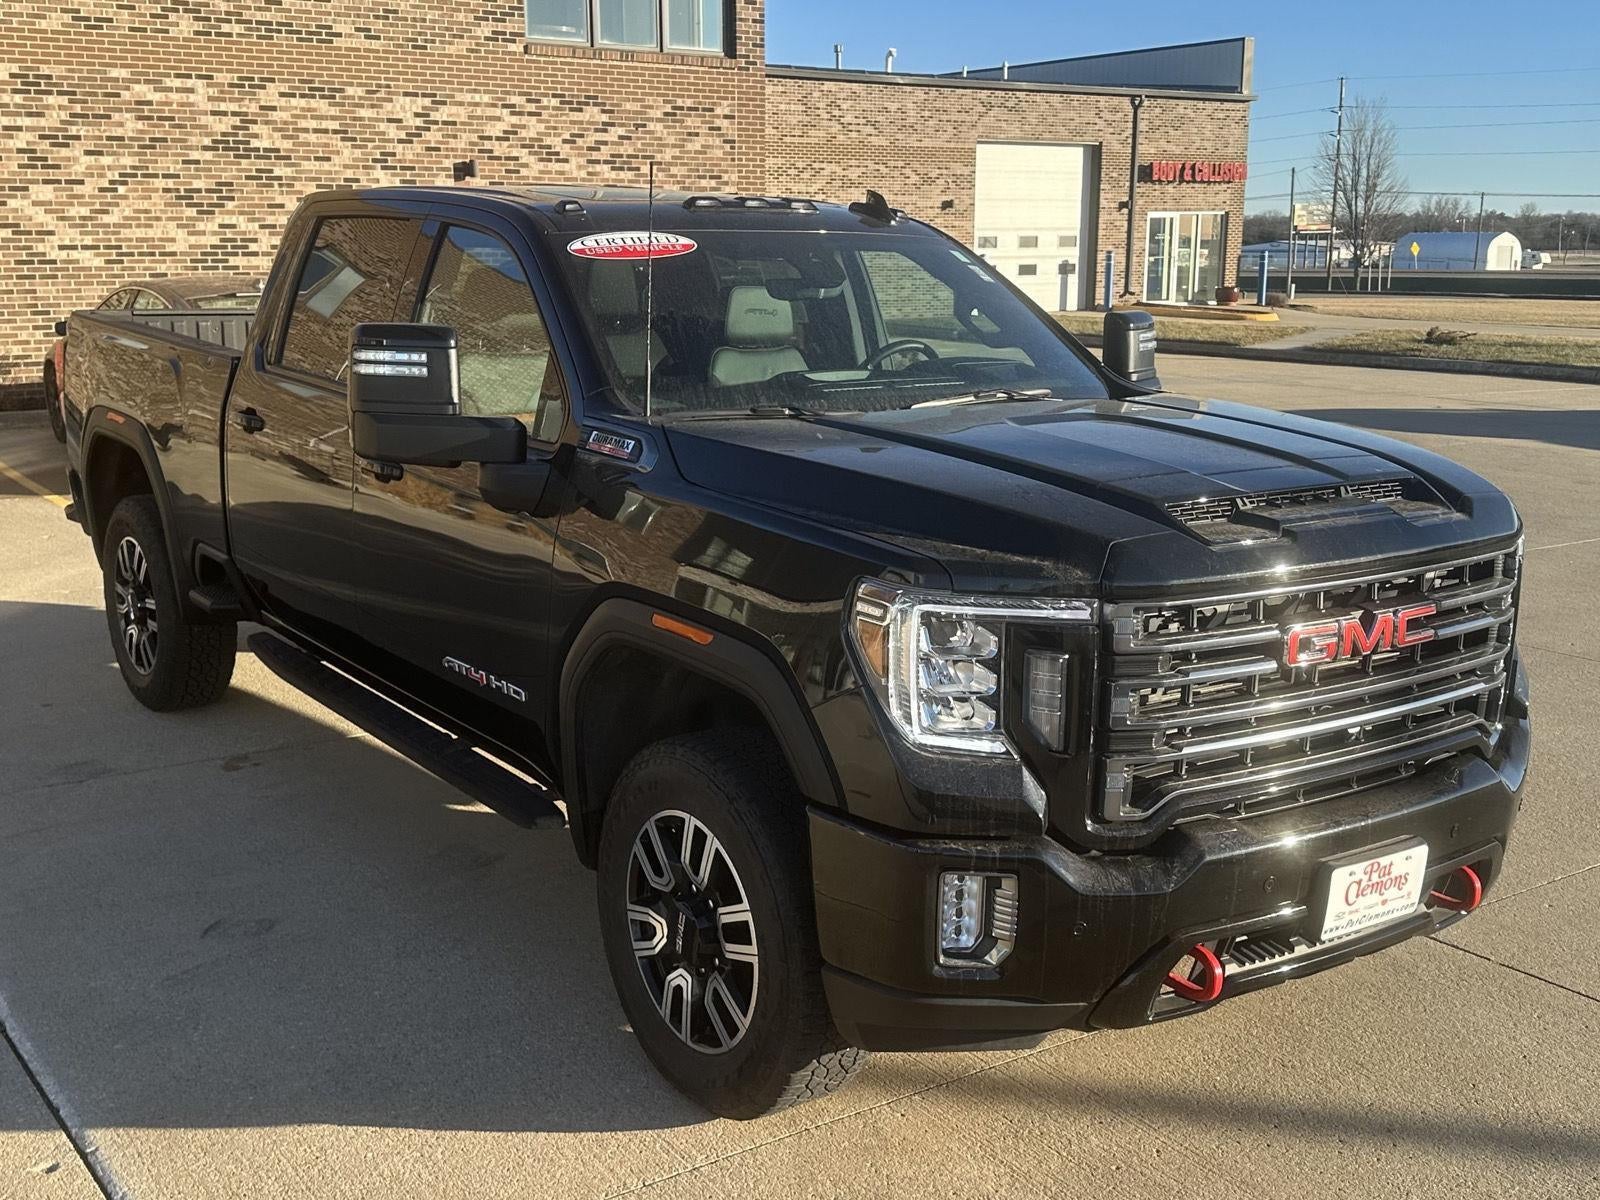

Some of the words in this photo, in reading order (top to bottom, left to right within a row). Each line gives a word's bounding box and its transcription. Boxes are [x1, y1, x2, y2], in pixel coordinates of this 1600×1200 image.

[1152, 160, 1182, 181] BODY
[1183, 161, 1193, 180] &
[1194, 160, 1248, 181] COLLISION
[580, 234, 680, 247] CERTIFIED
[585, 246, 622, 255] USED
[625, 243, 685, 253] VEHICLE
[589, 431, 635, 452] DURAMAX
[1285, 602, 1437, 667] GMC
[442, 656, 487, 686] AT4
[489, 674, 526, 702] HD
[1363, 860, 1395, 882] Pat
[1344, 872, 1410, 907] Clemons
[676, 911, 686, 955] GMC
